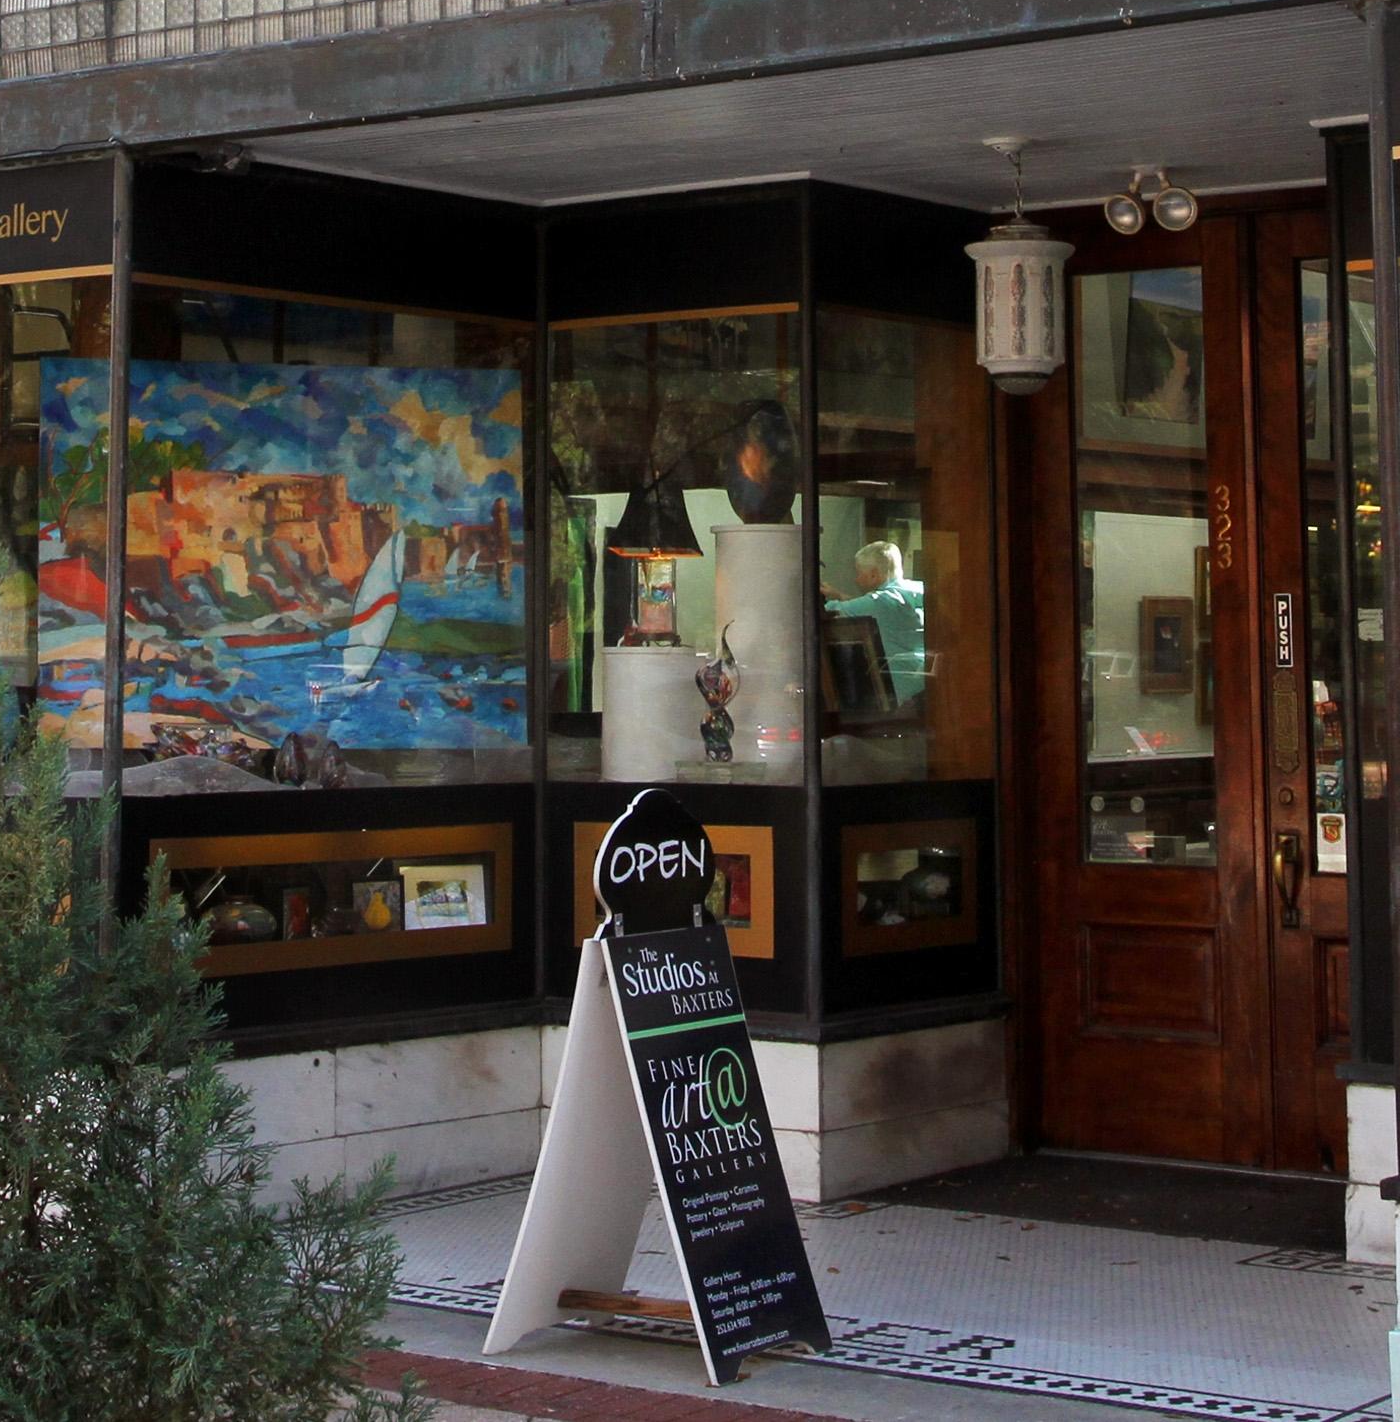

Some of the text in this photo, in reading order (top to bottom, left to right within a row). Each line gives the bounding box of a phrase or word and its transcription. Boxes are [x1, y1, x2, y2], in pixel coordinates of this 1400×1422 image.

[1215, 484, 1233, 570] 323
[1277, 600, 1290, 661] PUSH
[610, 838, 705, 884] OPEN
[640, 946, 659, 963] The
[622, 952, 706, 997] Studios
[671, 988, 734, 1015] BAXTERS
[647, 1055, 698, 1083] FINE
[664, 1118, 763, 1166] BAXTERS
[675, 1152, 768, 1184] GALLERY
[731, 1196, 765, 1213] Photography
[703, 1275, 723, 1287] Gallery
[707, 1291, 729, 1304] Monday
[732, 1285, 750, 1296] Friday
[711, 1306, 735, 1319] Saturday
